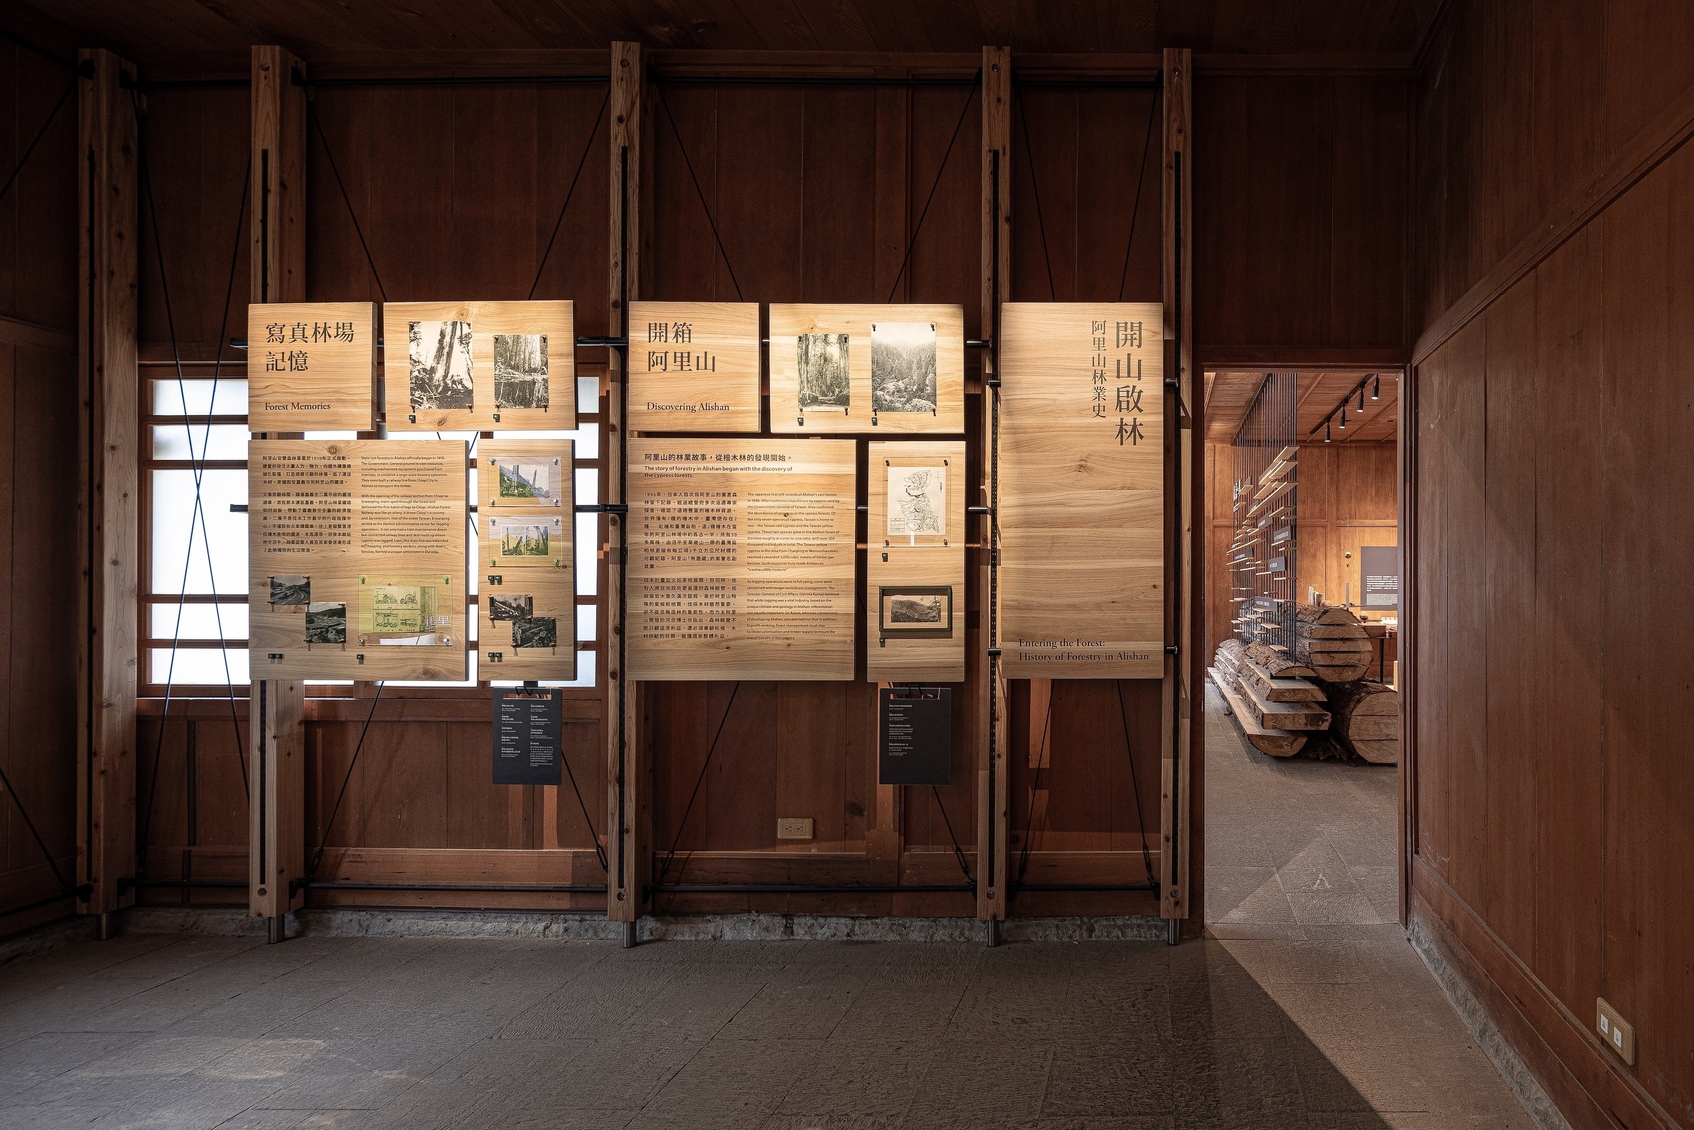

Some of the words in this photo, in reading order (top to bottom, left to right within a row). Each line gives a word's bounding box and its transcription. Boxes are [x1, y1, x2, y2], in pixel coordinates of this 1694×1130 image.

[265, 321, 355, 344] 寫真林場
[648, 321, 693, 344] 開箱
[265, 350, 309, 372] 記憶
[648, 351, 716, 372] 阿里山
[1091, 320, 1107, 419] 阿里山林業史
[1115, 320, 1144, 446] 開山啟林
[265, 402, 289, 411] Forest
[291, 402, 331, 411] Memories
[646, 401, 697, 414] Discovering
[698, 401, 730, 412] Alishan
[1019, 639, 1057, 649] Entering
[1059, 638, 1074, 647] the
[1076, 639, 1105, 647] Forest:
[1019, 652, 1053, 663] History
[1055, 652, 1065, 661] of
[1067, 652, 1102, 663] Forestry
[1105, 652, 1113, 661] in
[1115, 652, 1149, 661] Alishan
